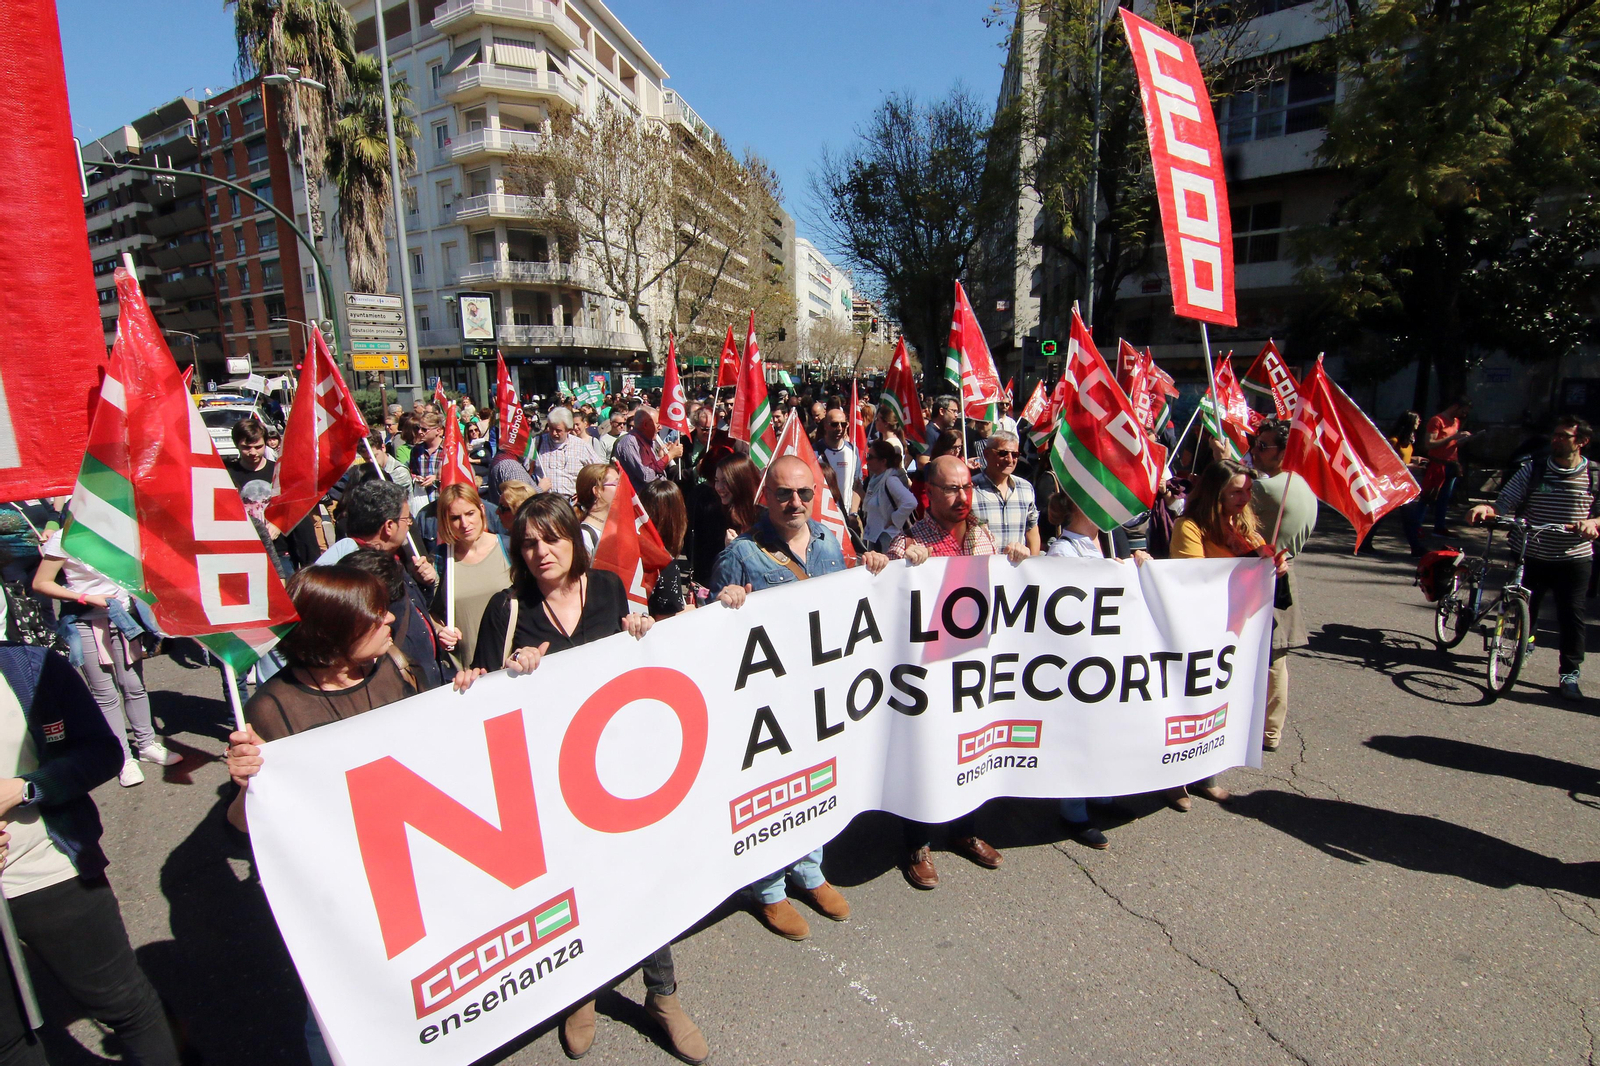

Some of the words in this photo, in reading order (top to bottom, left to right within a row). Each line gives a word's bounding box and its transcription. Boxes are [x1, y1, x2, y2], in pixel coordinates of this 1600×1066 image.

[1138, 26, 1223, 312] CCOO
[509, 408, 523, 444] Córdoba
[1271, 387, 1285, 416] Córdoba
[734, 625, 787, 691] A
[808, 597, 883, 667] LA
[909, 585, 1125, 643] LOMCE
[741, 705, 793, 771] A
[814, 663, 929, 742] LOS
[952, 645, 1237, 713] RECORTES
[956, 754, 1038, 786] enseñanza
[1161, 734, 1225, 765] enseñanza
[345, 667, 709, 961] NO
[733, 795, 837, 856] enseñanza
[734, 775, 807, 825] CCOO
[419, 938, 585, 1045] enseñanza
[421, 921, 532, 1009] CCOO
